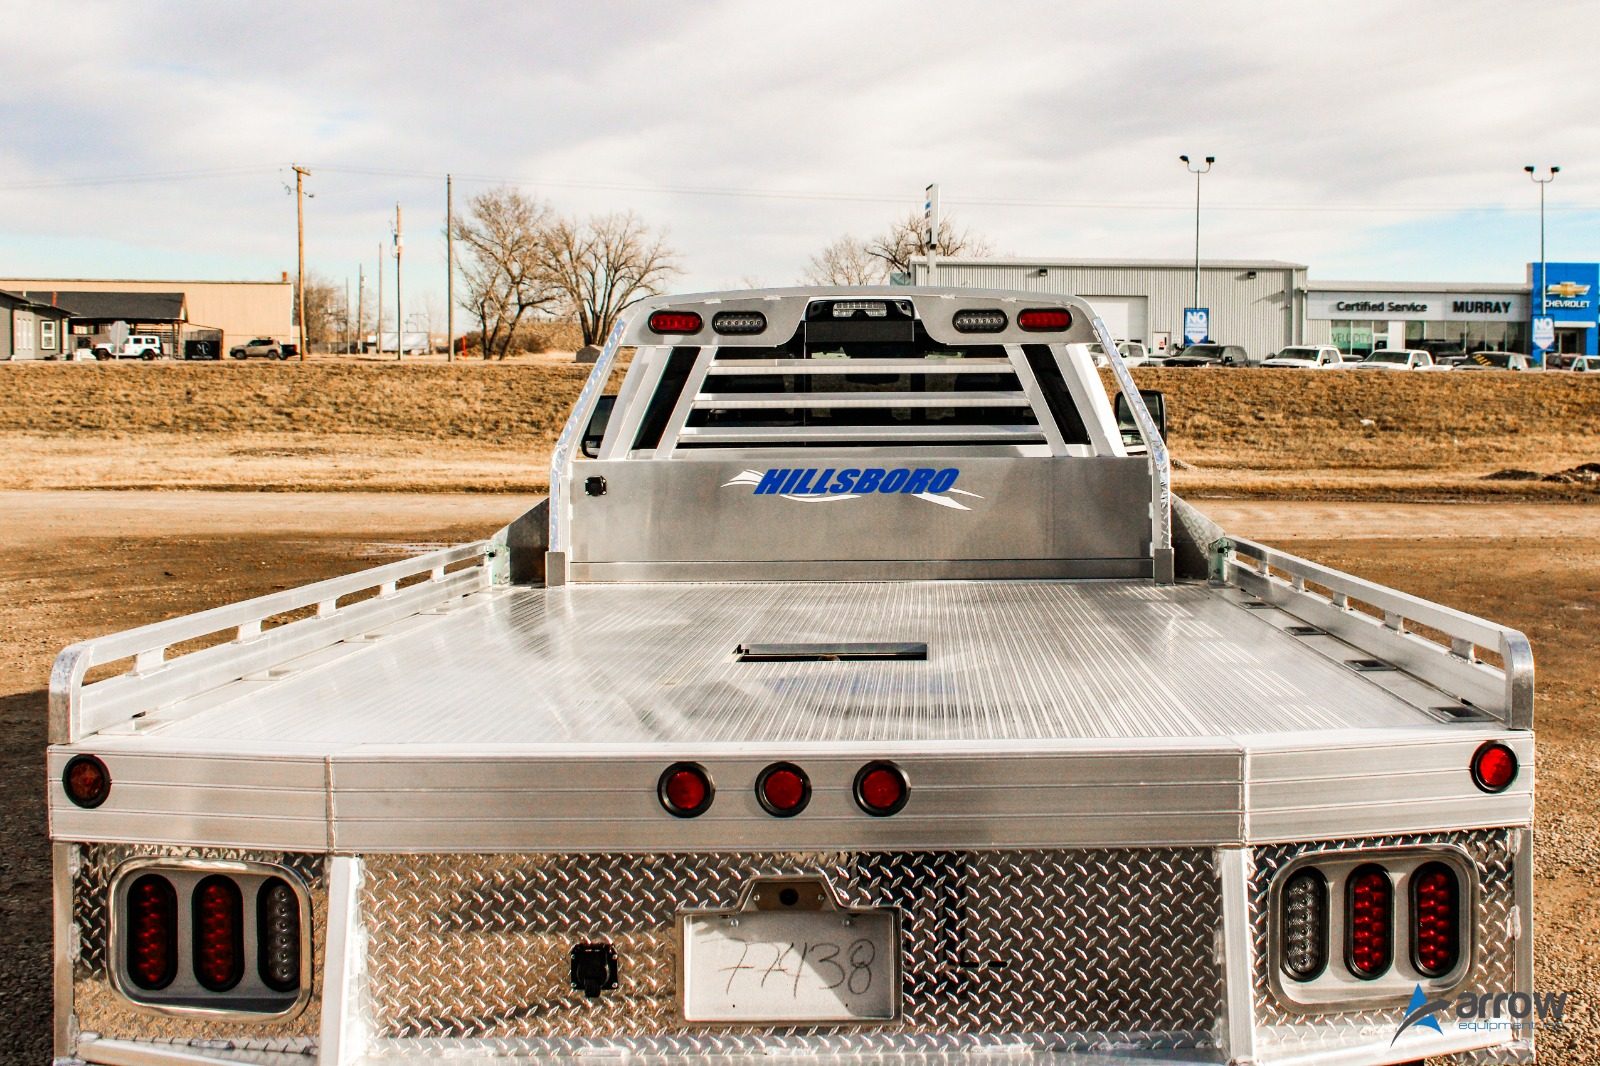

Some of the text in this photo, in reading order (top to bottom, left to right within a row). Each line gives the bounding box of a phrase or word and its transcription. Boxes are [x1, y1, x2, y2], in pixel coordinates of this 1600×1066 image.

[1336, 301, 1428, 312] Certified Service
[1452, 301, 1511, 313] MURRAY
[1545, 300, 1591, 308] CHEVROLET
[1186, 311, 1207, 323] NO
[1534, 318, 1553, 330] NO
[753, 468, 960, 495] HILLSBORO
